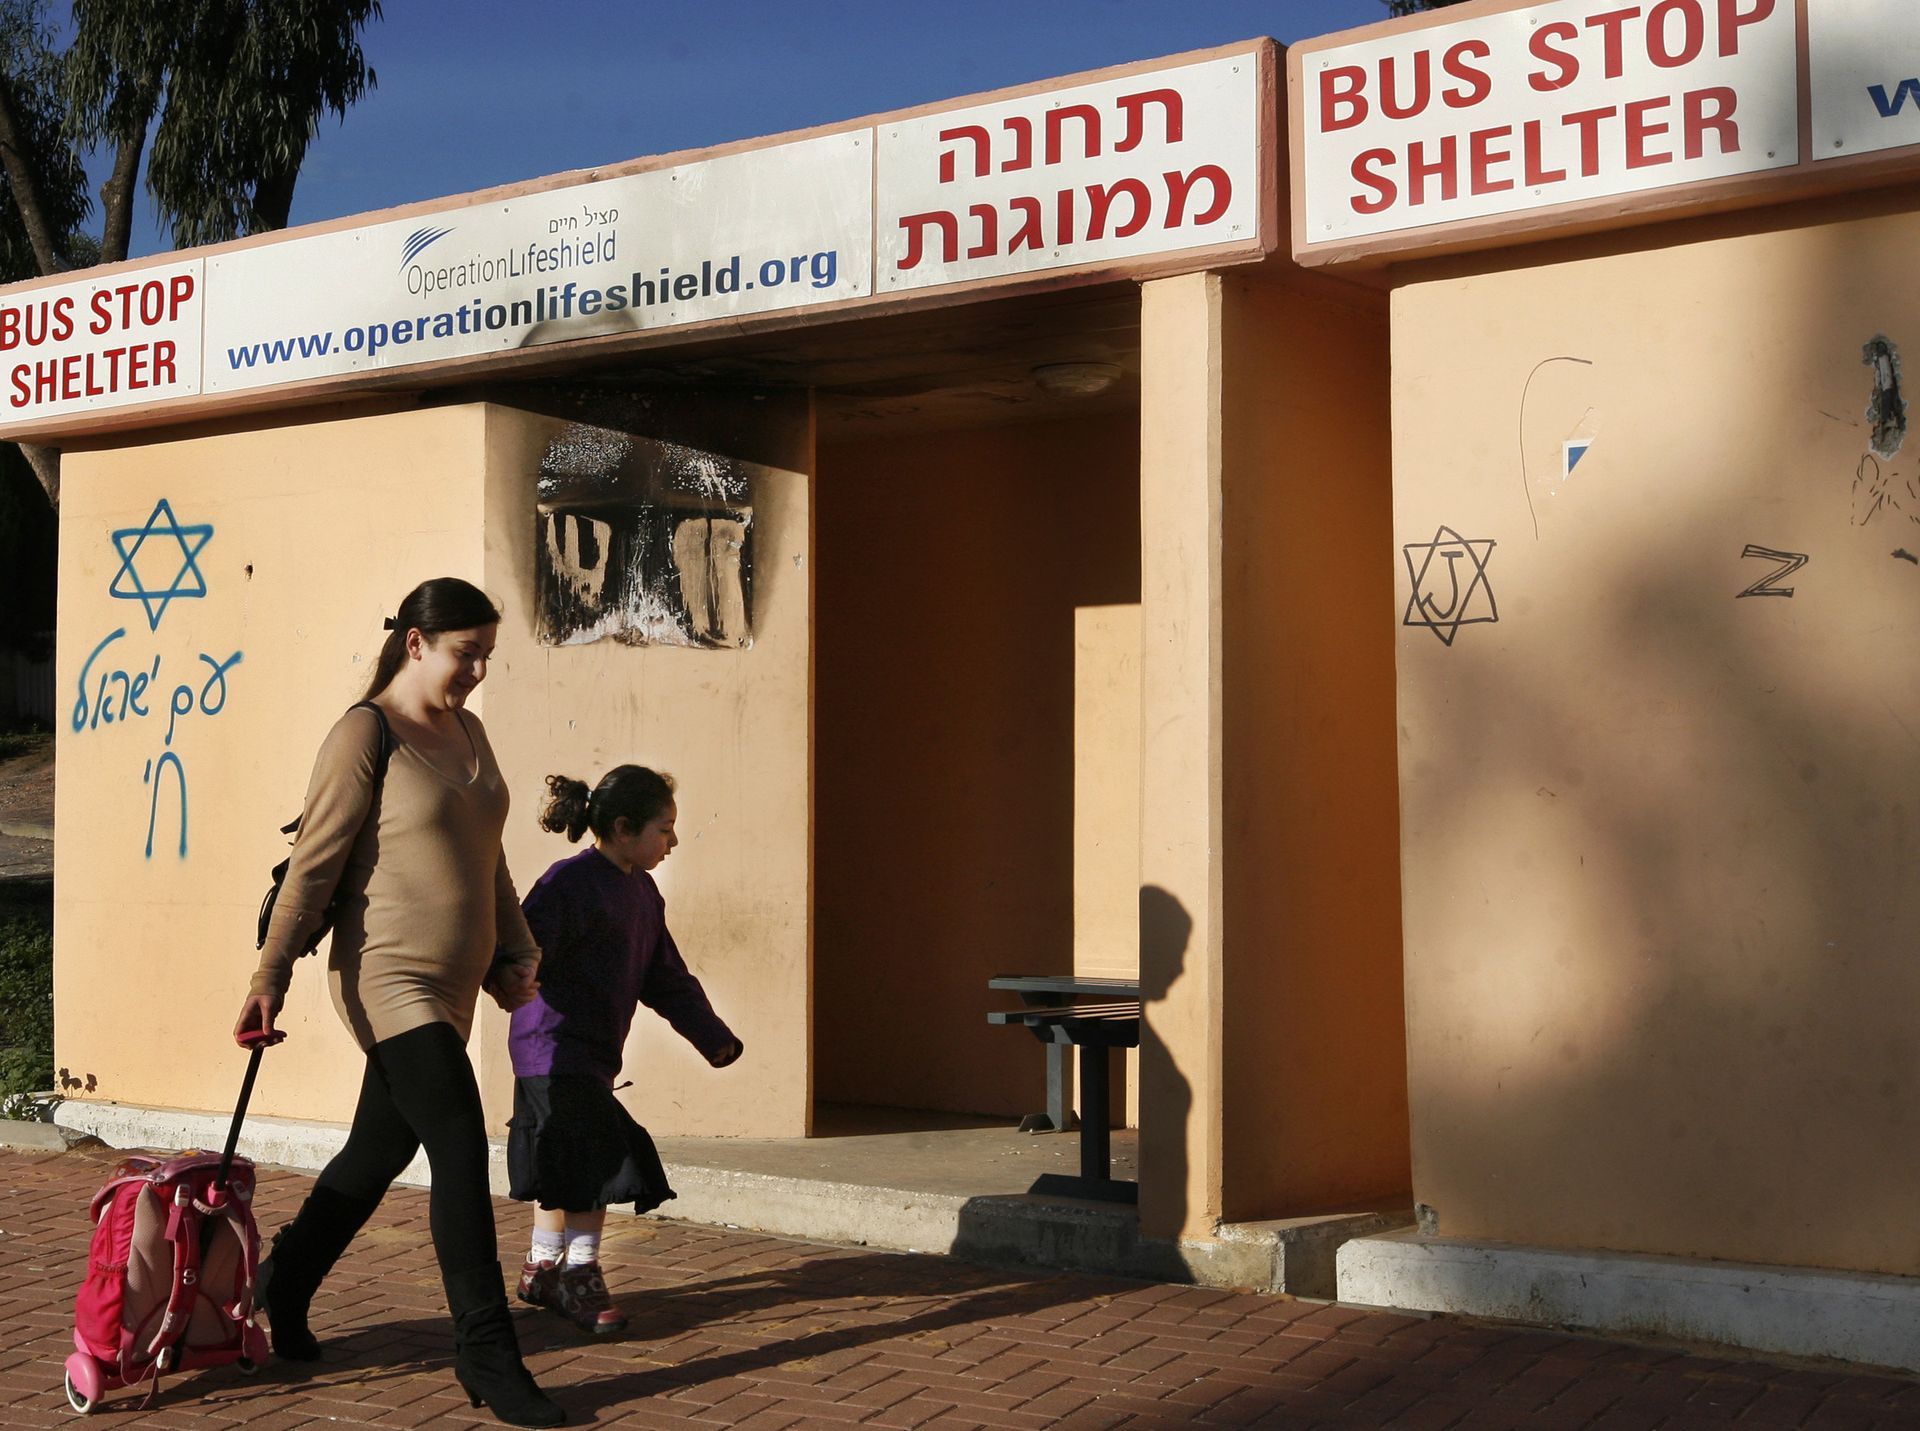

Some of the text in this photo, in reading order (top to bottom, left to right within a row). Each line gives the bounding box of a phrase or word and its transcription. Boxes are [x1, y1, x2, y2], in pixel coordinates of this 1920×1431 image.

[1319, 0, 1776, 133] BUS STOP
[938, 88, 1184, 184] תחנה
[1350, 86, 1741, 215] SHELTER
[549, 205, 619, 233] מציל חיים
[896, 164, 1233, 271] ממוגנת
[0, 275, 195, 351] BUS STOP
[227, 250, 837, 370] www.operationlifeshield.org
[10, 340, 177, 408] SHELTER
[71, 626, 244, 745] עם ישראל
[143, 751, 188, 859] חי
